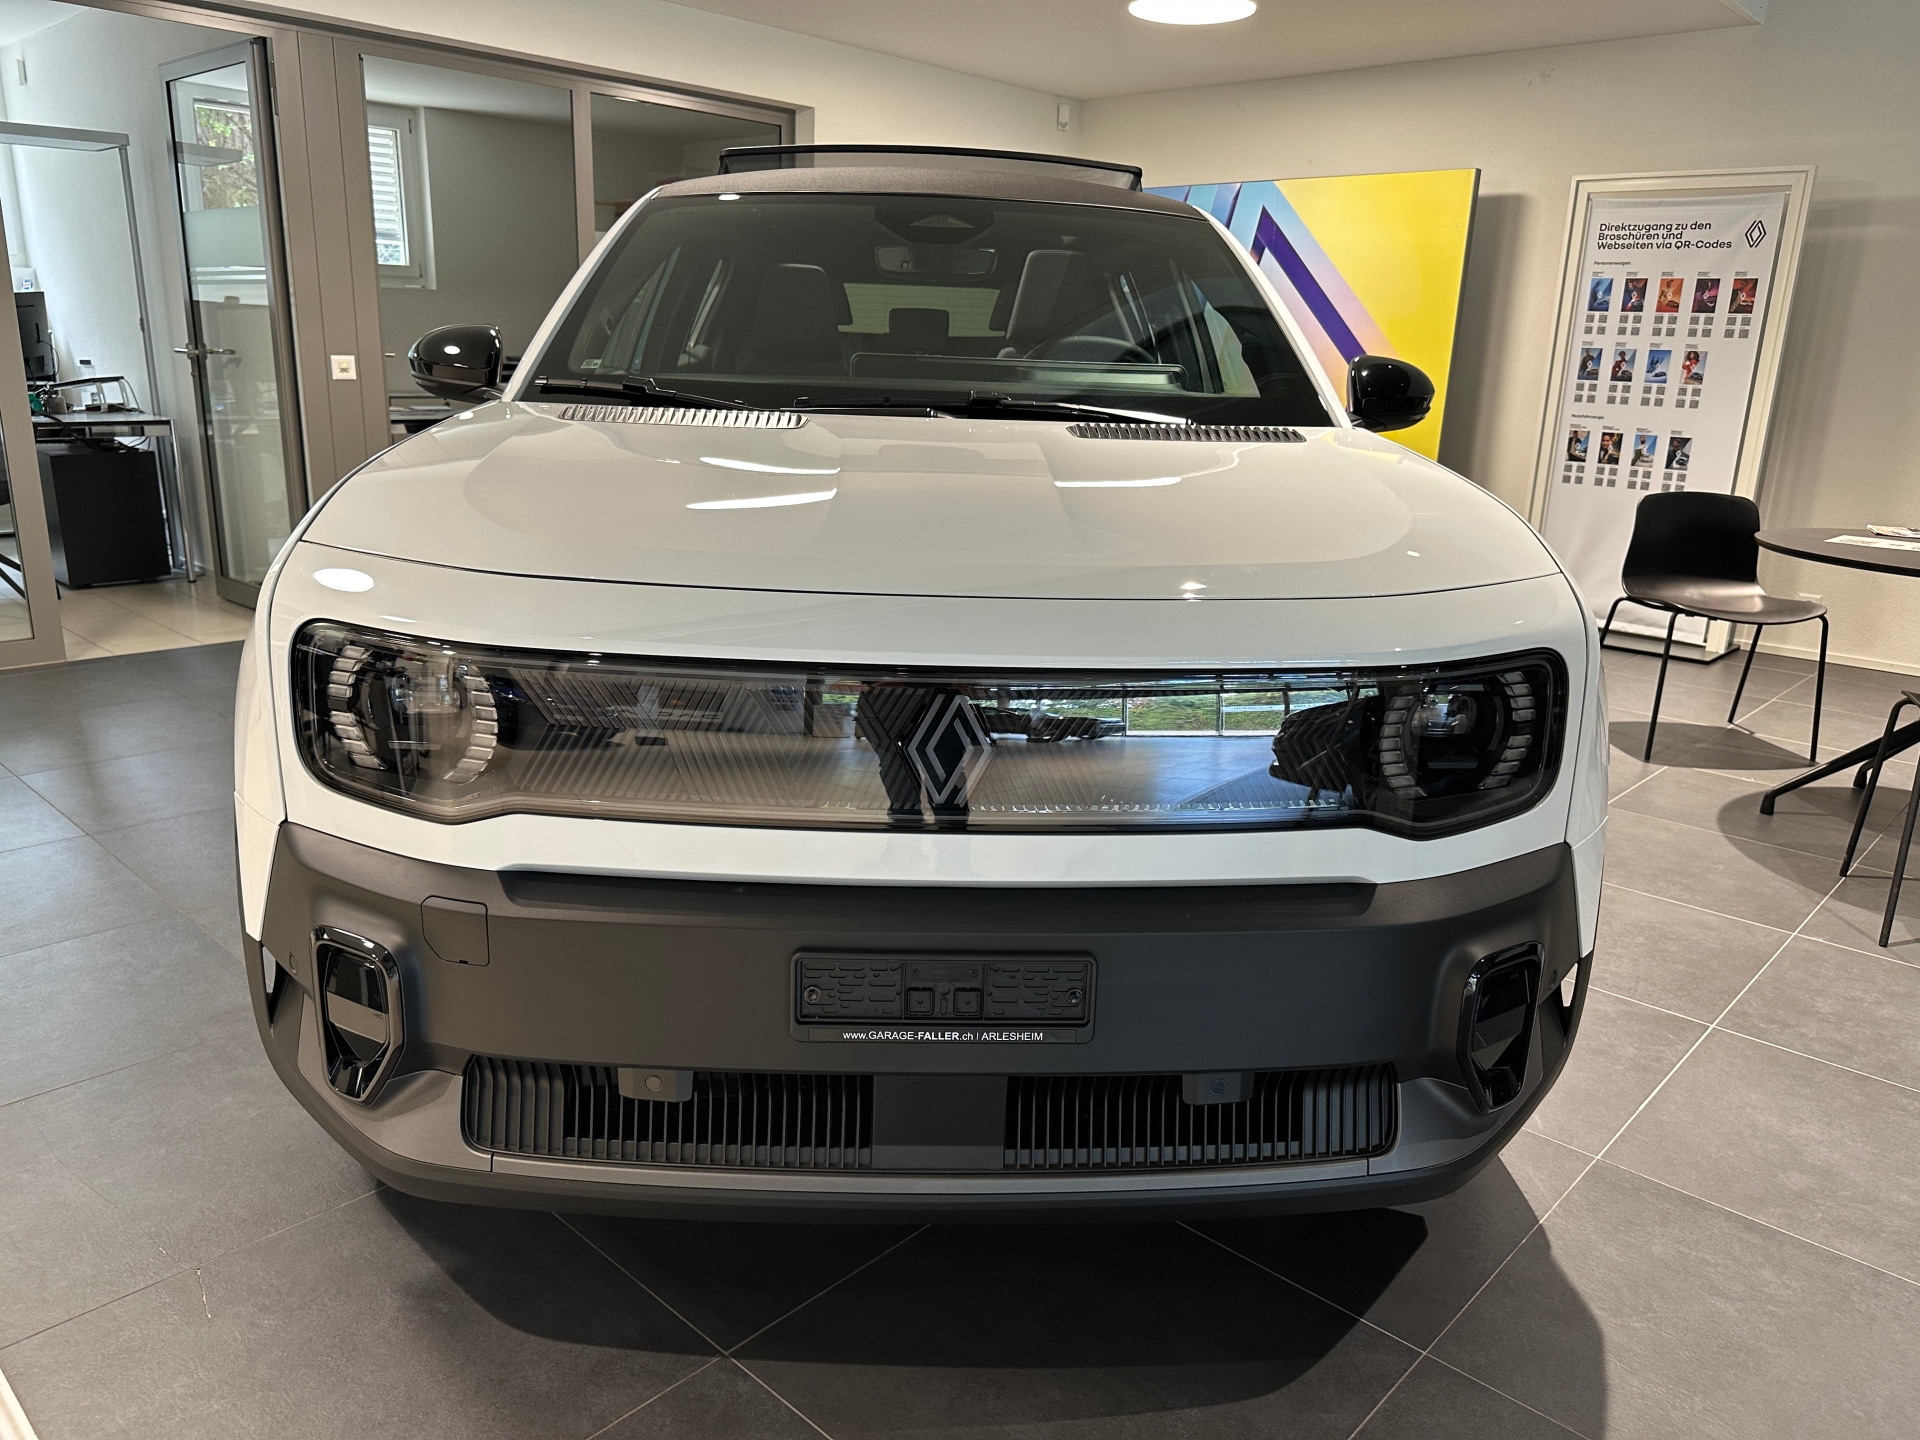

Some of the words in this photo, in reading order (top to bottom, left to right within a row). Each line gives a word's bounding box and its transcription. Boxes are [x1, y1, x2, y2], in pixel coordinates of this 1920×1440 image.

[1599, 223, 1673, 233] Direktzugang
[1675, 222, 1689, 231] zu
[1690, 221, 1712, 230] den
[1598, 231, 1660, 241] Broschüren
[1661, 231, 1683, 240] und
[1597, 240, 1654, 250] Webseiten
[1655, 240, 1672, 250] via
[1674, 239, 1733, 250] QR-Codes
[842, 1030, 974, 1041] www.GARAGE-FALLER.ch
[981, 1031, 1044, 1041] ARLESHEIM
